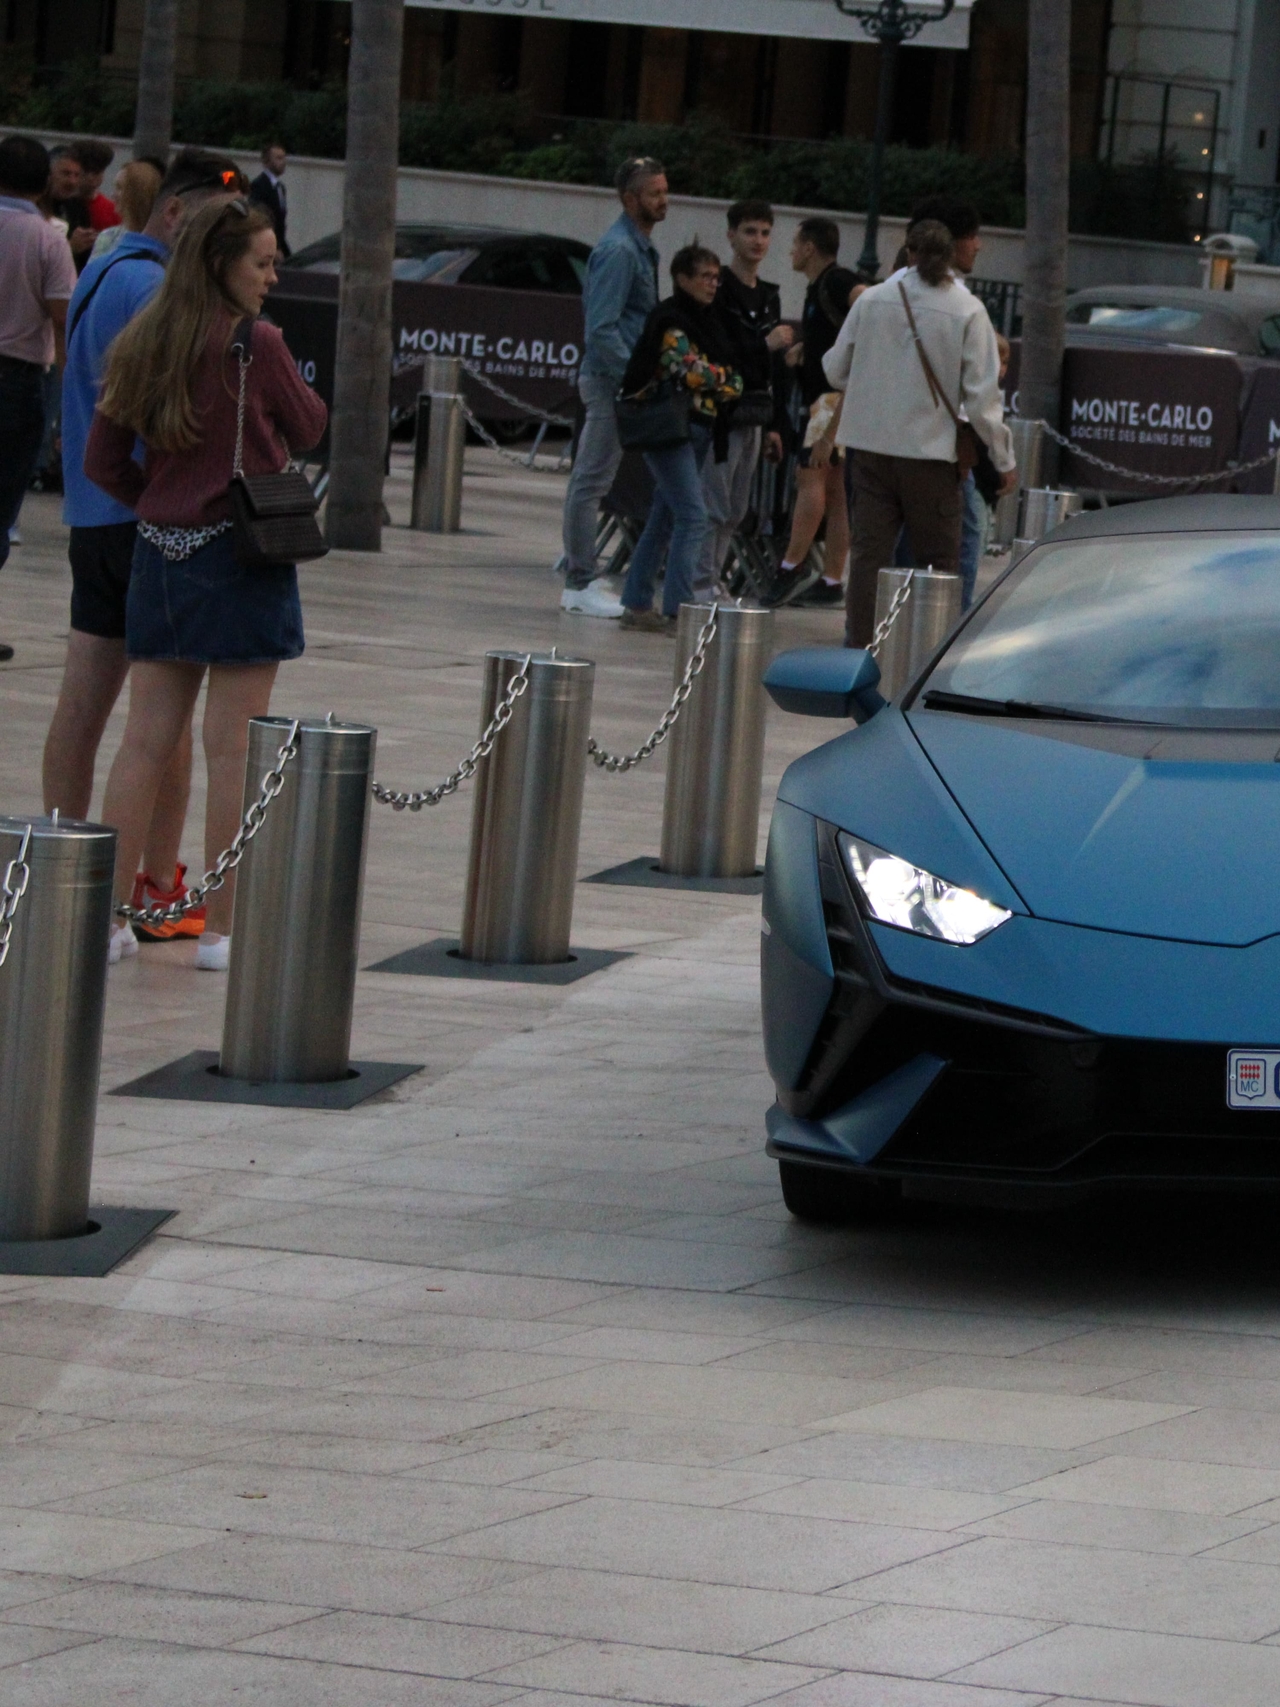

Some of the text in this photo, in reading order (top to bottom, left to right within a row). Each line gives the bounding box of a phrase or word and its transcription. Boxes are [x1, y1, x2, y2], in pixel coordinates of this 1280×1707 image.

[485, 361, 524, 377] BAINS
[528, 367, 545, 378] DE
[1171, 434, 1186, 447] DE
[1240, 1081, 1259, 1093] MC
